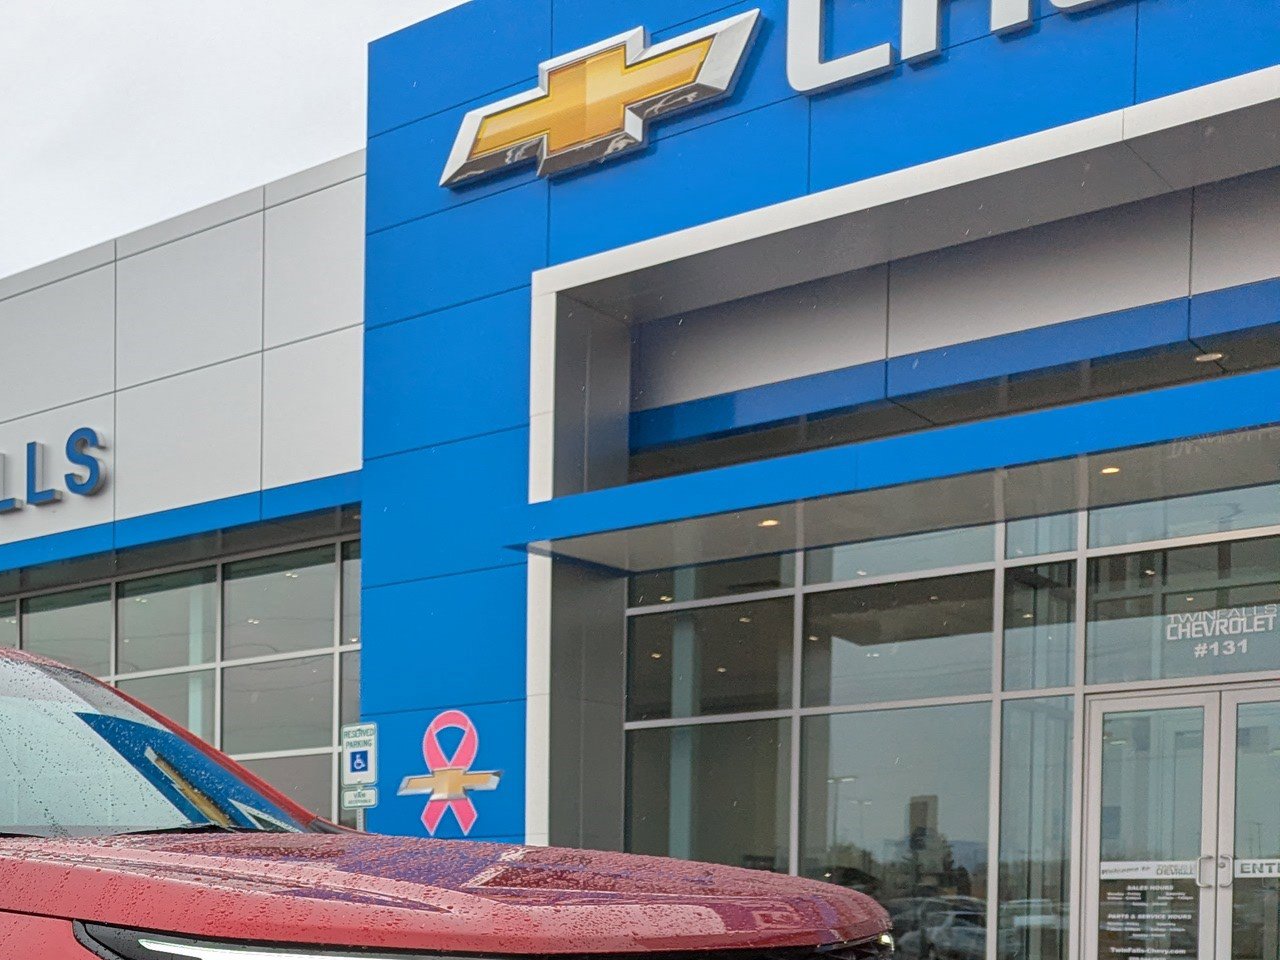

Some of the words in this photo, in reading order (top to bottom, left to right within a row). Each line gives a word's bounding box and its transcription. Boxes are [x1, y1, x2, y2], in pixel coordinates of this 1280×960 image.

[1166, 613, 1277, 640] CHEVROLET
[1194, 638, 1248, 659] #131
[343, 728, 375, 739] RESERVED
[346, 739, 372, 749] PARKING
[1240, 862, 1280, 874] ENT
